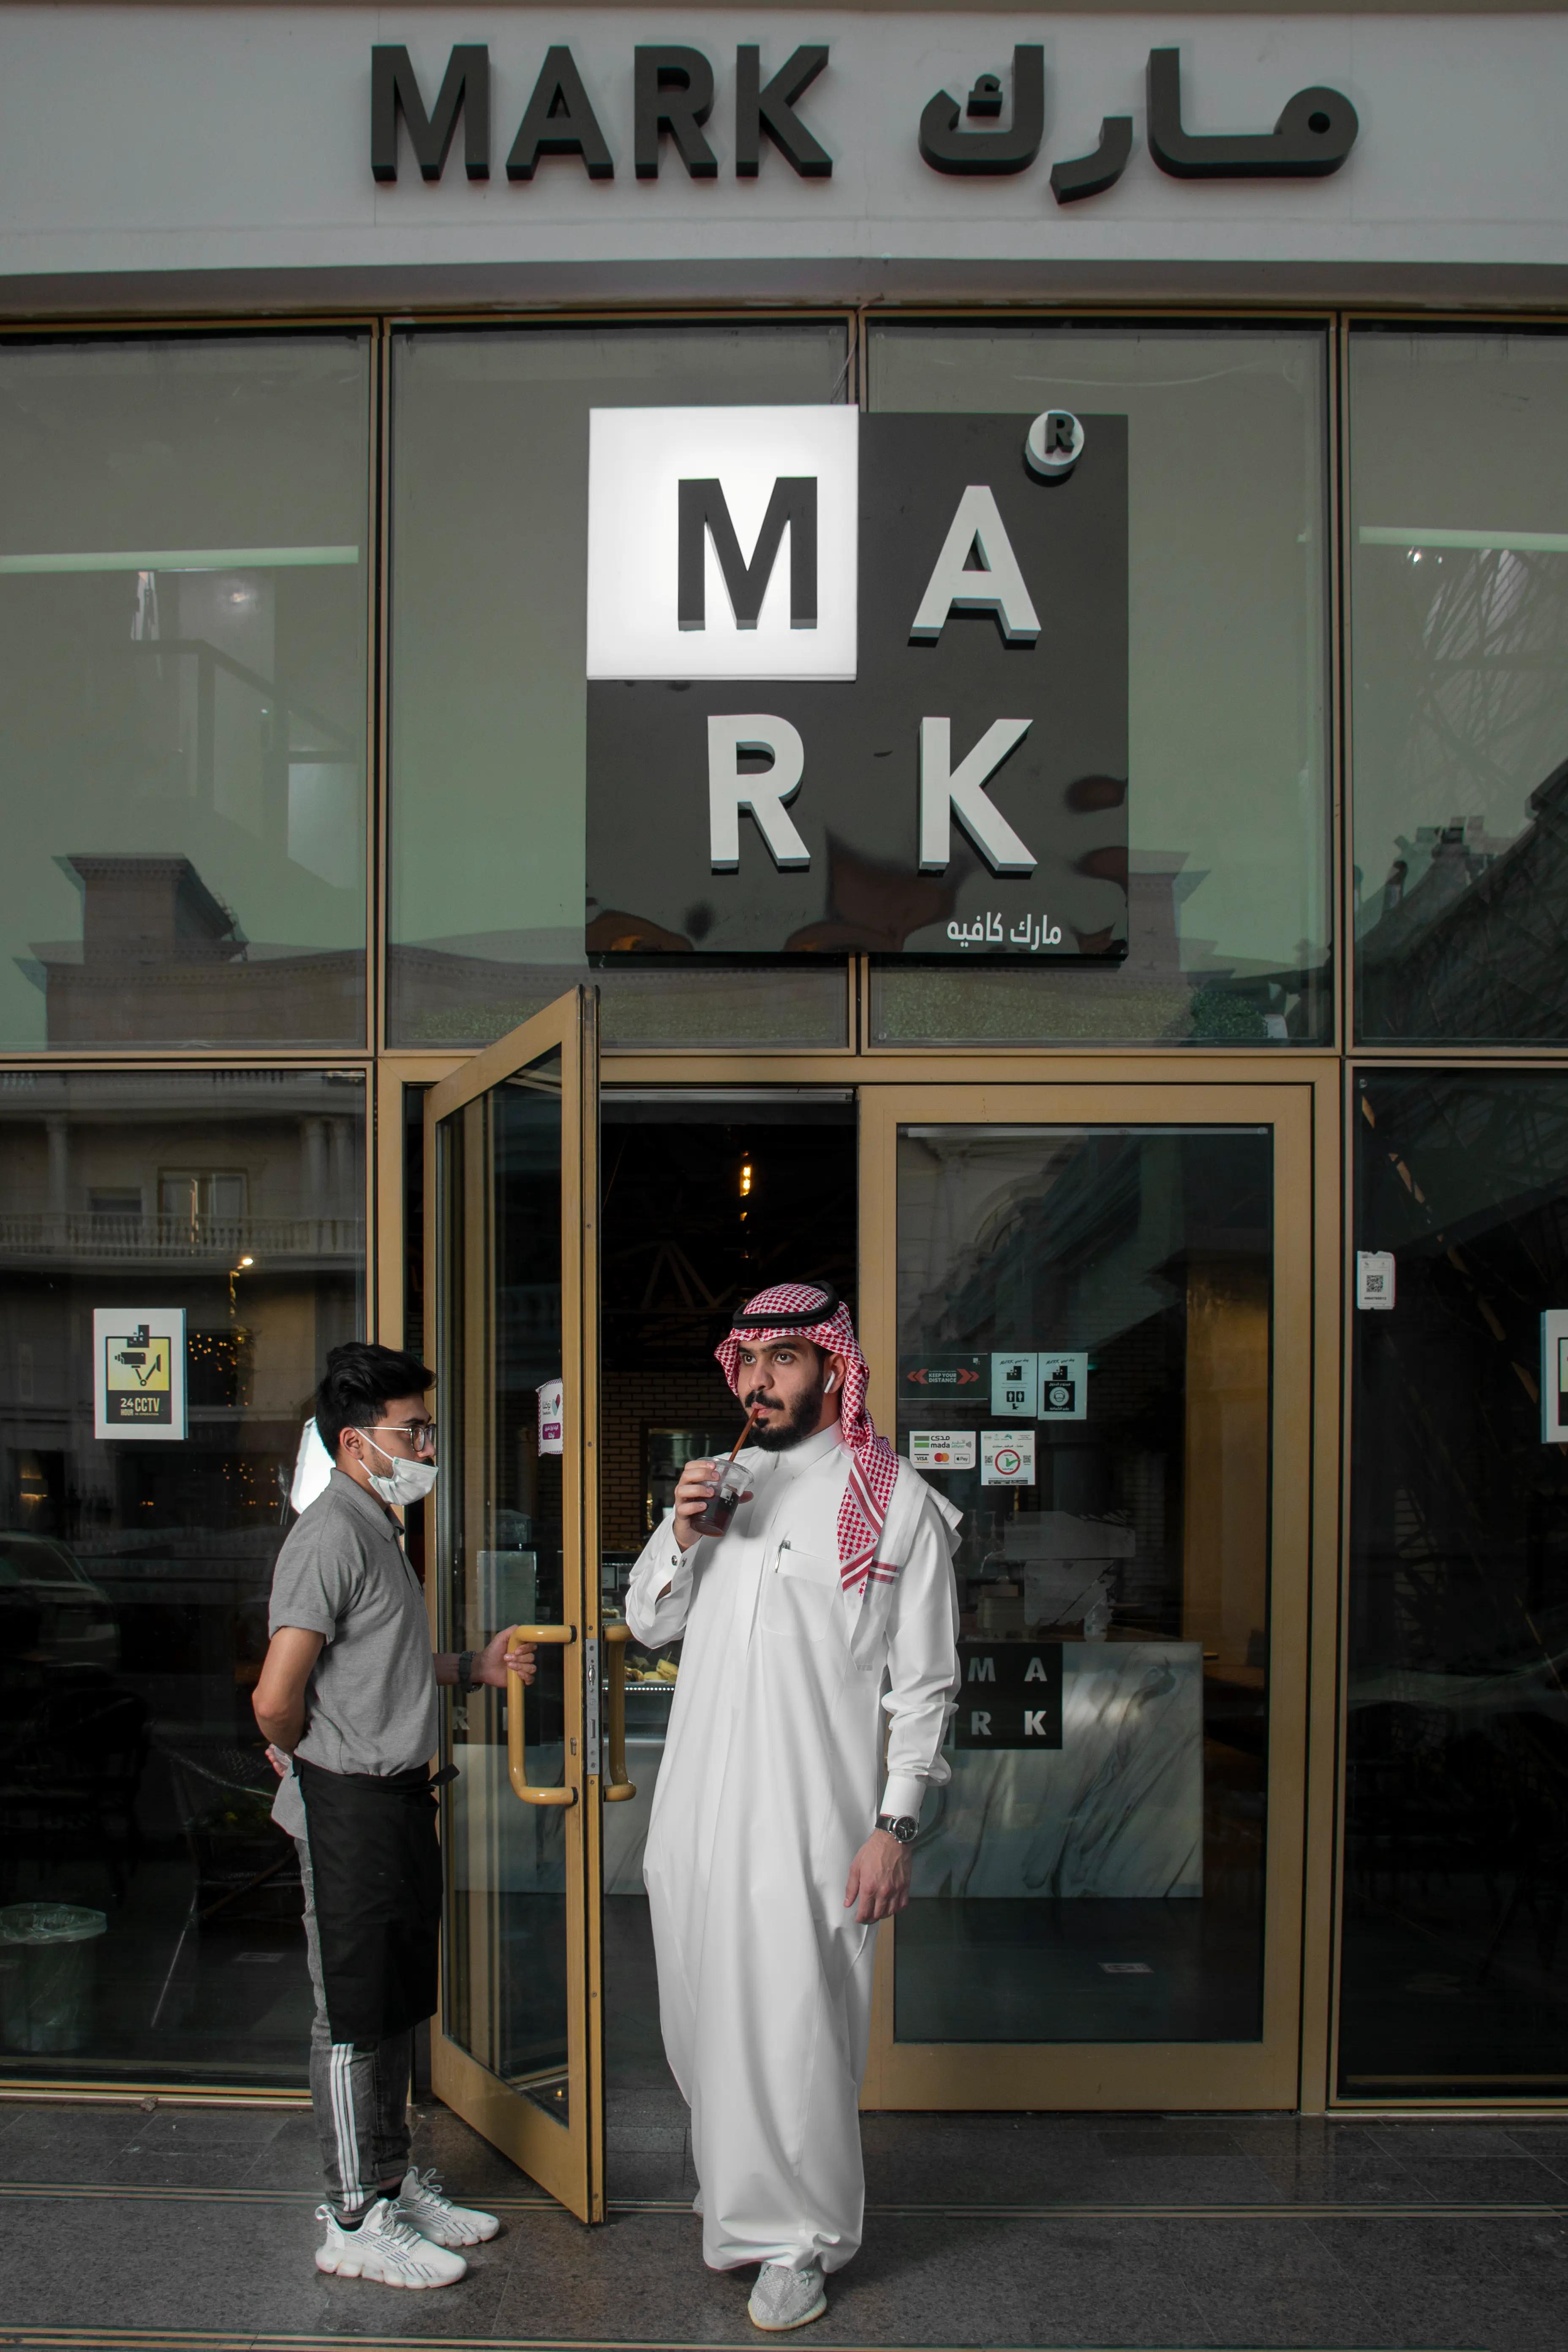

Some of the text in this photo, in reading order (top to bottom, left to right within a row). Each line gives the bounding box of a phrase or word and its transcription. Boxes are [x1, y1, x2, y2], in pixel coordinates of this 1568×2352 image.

[371, 44, 833, 182] MARK
[918, 44, 1359, 204] مارك
[947, 912, 1062, 950] مارك كافيه
[120, 1397, 160, 1412] 24 CCTV
